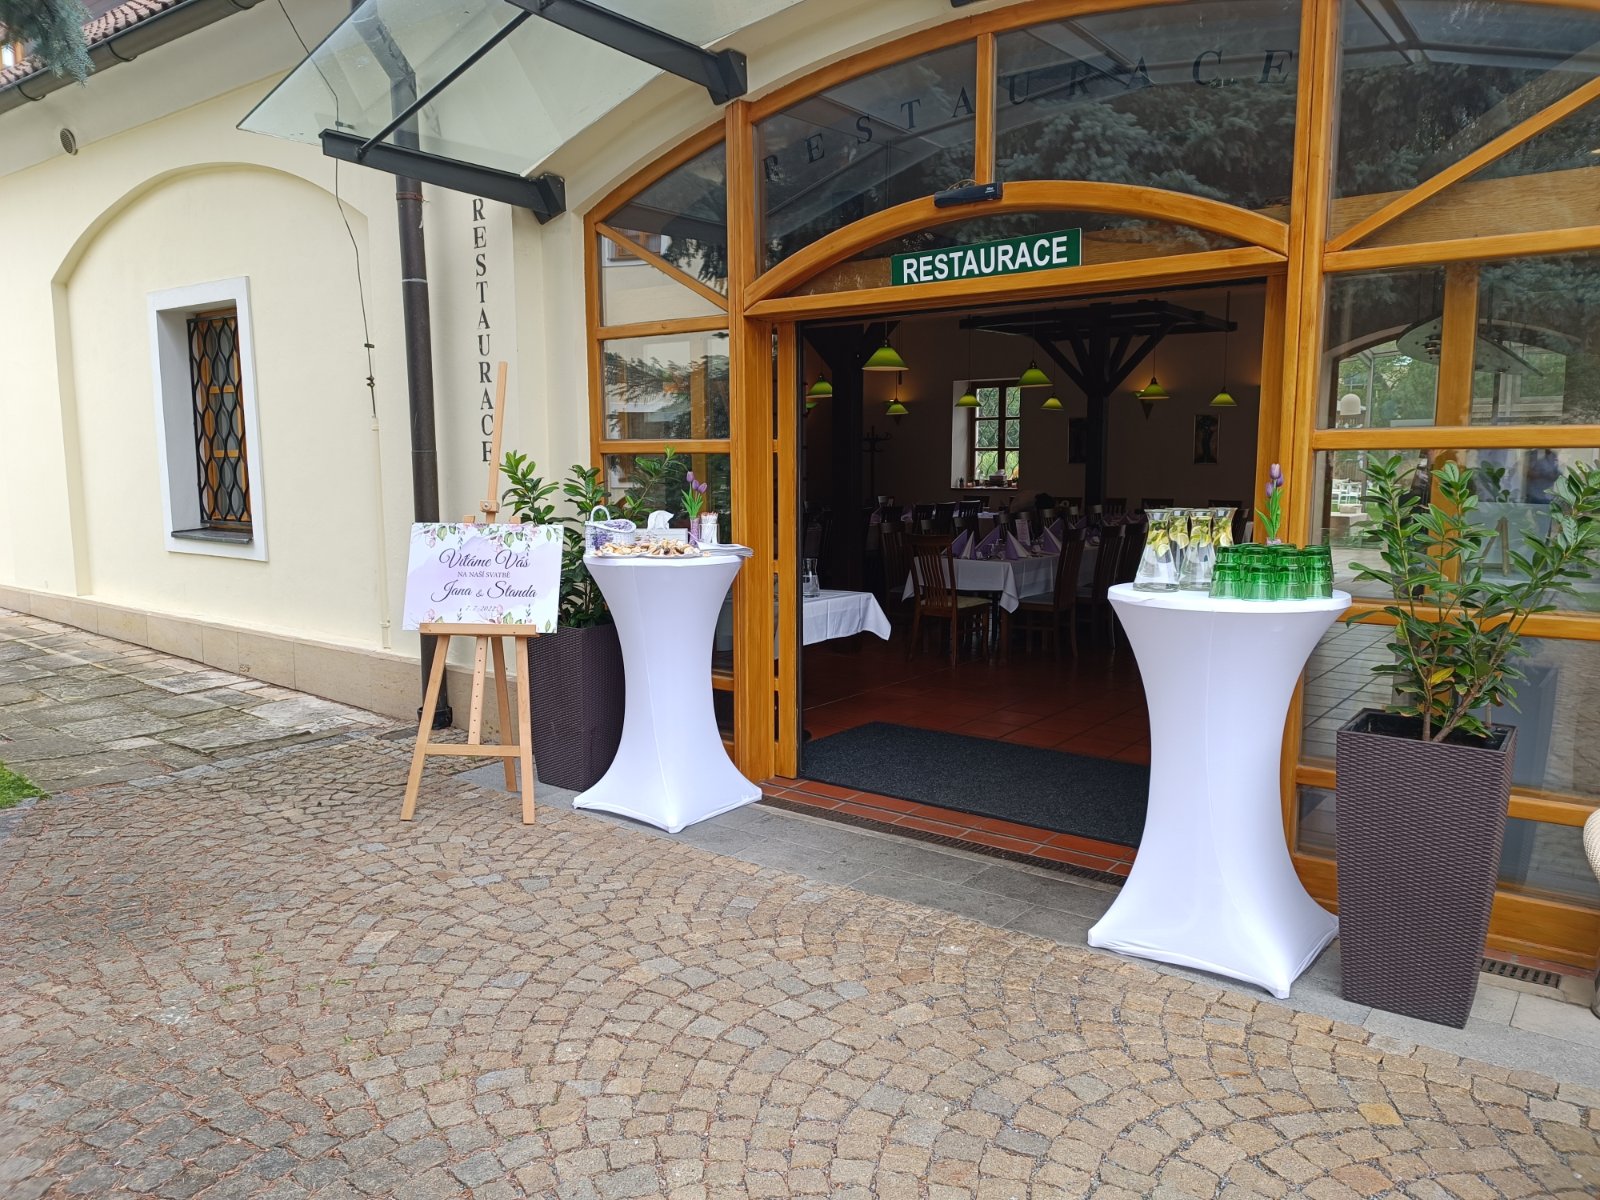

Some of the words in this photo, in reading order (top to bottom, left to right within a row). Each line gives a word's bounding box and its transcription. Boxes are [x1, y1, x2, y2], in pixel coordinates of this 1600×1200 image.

[762, 49, 1293, 183] RESTAURACE
[902, 235, 1068, 284] RESTAURACE
[472, 198, 494, 462] RESTAURACE
[495, 549, 530, 569] Vás
[430, 580, 472, 602] Jana
[487, 580, 537, 598] Standa
